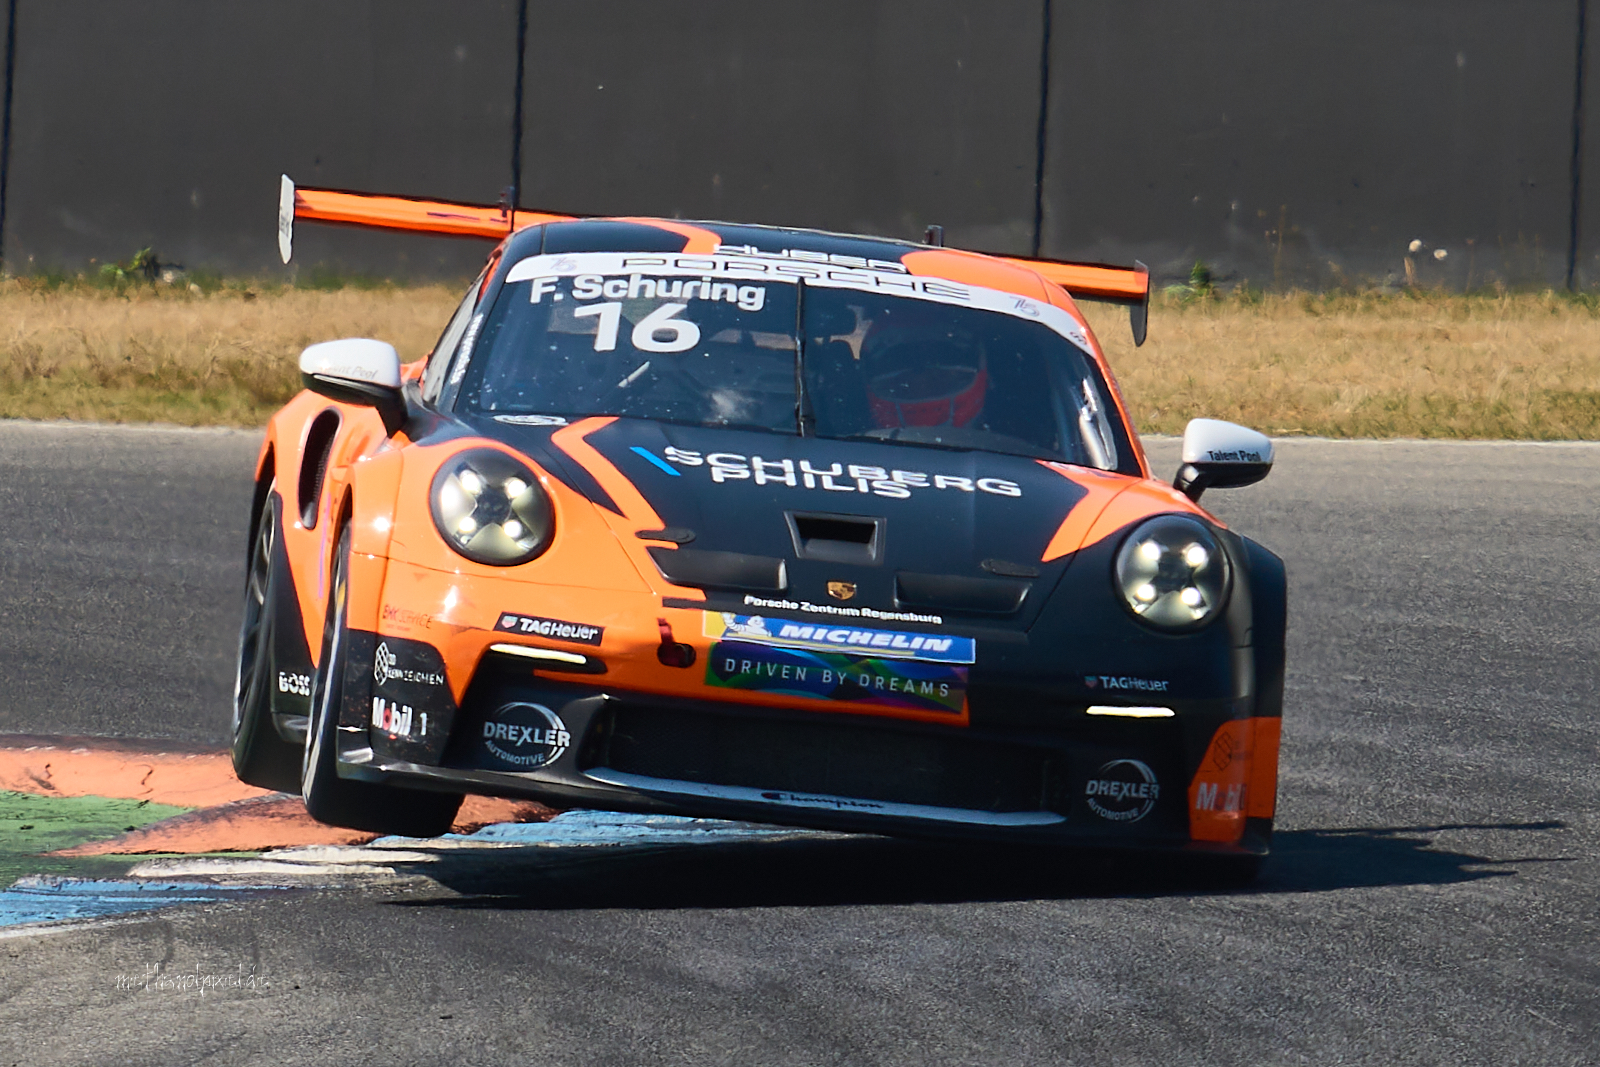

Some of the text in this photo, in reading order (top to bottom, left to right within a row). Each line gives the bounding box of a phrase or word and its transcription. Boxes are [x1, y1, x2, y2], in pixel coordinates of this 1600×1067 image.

[530, 273, 767, 312] F. Schuring
[622, 257, 970, 301] PORSCHE
[573, 301, 701, 353] 16
[663, 445, 1022, 498] SCHUBERG
[710, 465, 911, 499] PHILIS
[743, 594, 943, 625] Porsche Zentrum Regensburg
[779, 624, 953, 652] MICHELIN
[724, 657, 950, 698] DRIVEN BY DREAMS
[372, 696, 428, 736] Mobil 1
[483, 721, 572, 748] DREXLER
[484, 740, 546, 766] AUTOMOTIVE
[1085, 780, 1160, 803] DREXLER
[1086, 797, 1139, 821] AUTOMOTIVE
